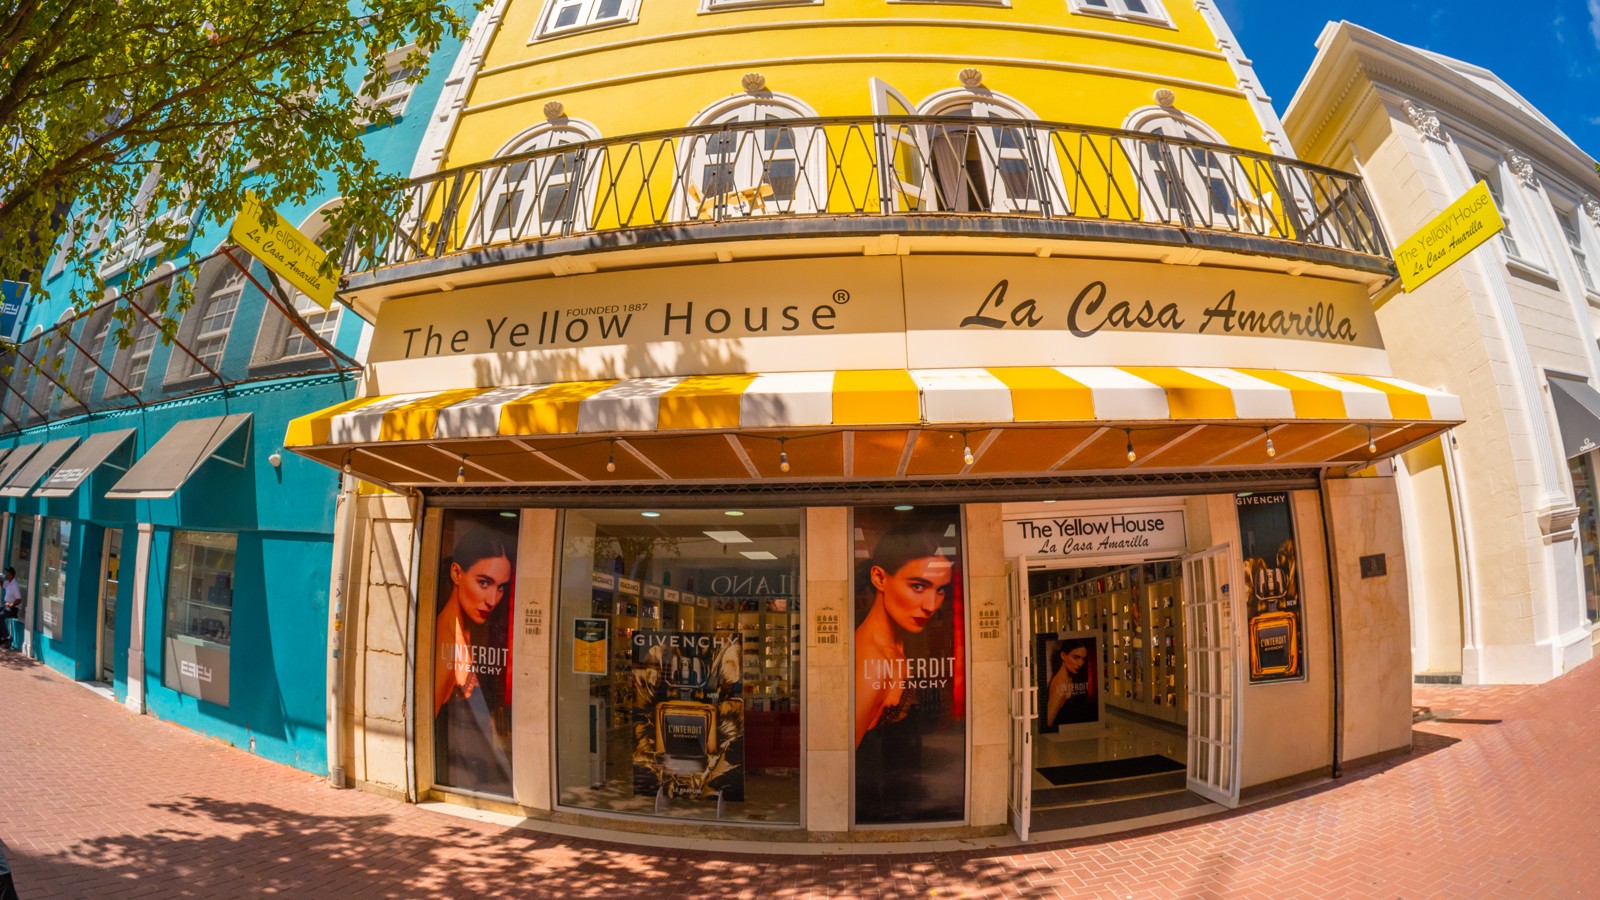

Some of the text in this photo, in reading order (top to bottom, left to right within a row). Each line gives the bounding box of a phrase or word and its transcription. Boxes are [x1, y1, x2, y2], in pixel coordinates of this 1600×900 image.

[246, 199, 263, 223] Th
[306, 250, 337, 284] Hoe
[1397, 246, 1419, 266] The
[1417, 221, 1453, 250] Yellow
[1452, 194, 1489, 226] House
[245, 228, 261, 244] La
[262, 240, 284, 263] Casa
[285, 260, 321, 291] Amarilla
[1412, 261, 1424, 277] La
[1426, 247, 1447, 269] Casa
[1448, 220, 1484, 253] Amarilla
[566, 302, 648, 317] FOUNDED 1887
[959, 279, 1358, 342] La Casa Amarilla
[403, 324, 470, 359] The
[486, 310, 633, 349] Yellow
[1236, 494, 1286, 506] GIVENCHY
[1017, 516, 1165, 539] The Yellow House
[1038, 535, 1150, 555] La Casa Amarilla
[633, 634, 740, 649] GIVENCHY
[441, 642, 509, 667] L'INTERDIT
[181, 660, 212, 683] EFFY
[446, 662, 502, 676] GIVENCHY
[863, 656, 956, 680] L'INTERDIT
[871, 679, 948, 690] GIVENCHY
[668, 724, 702, 735] L'INTERDIT
